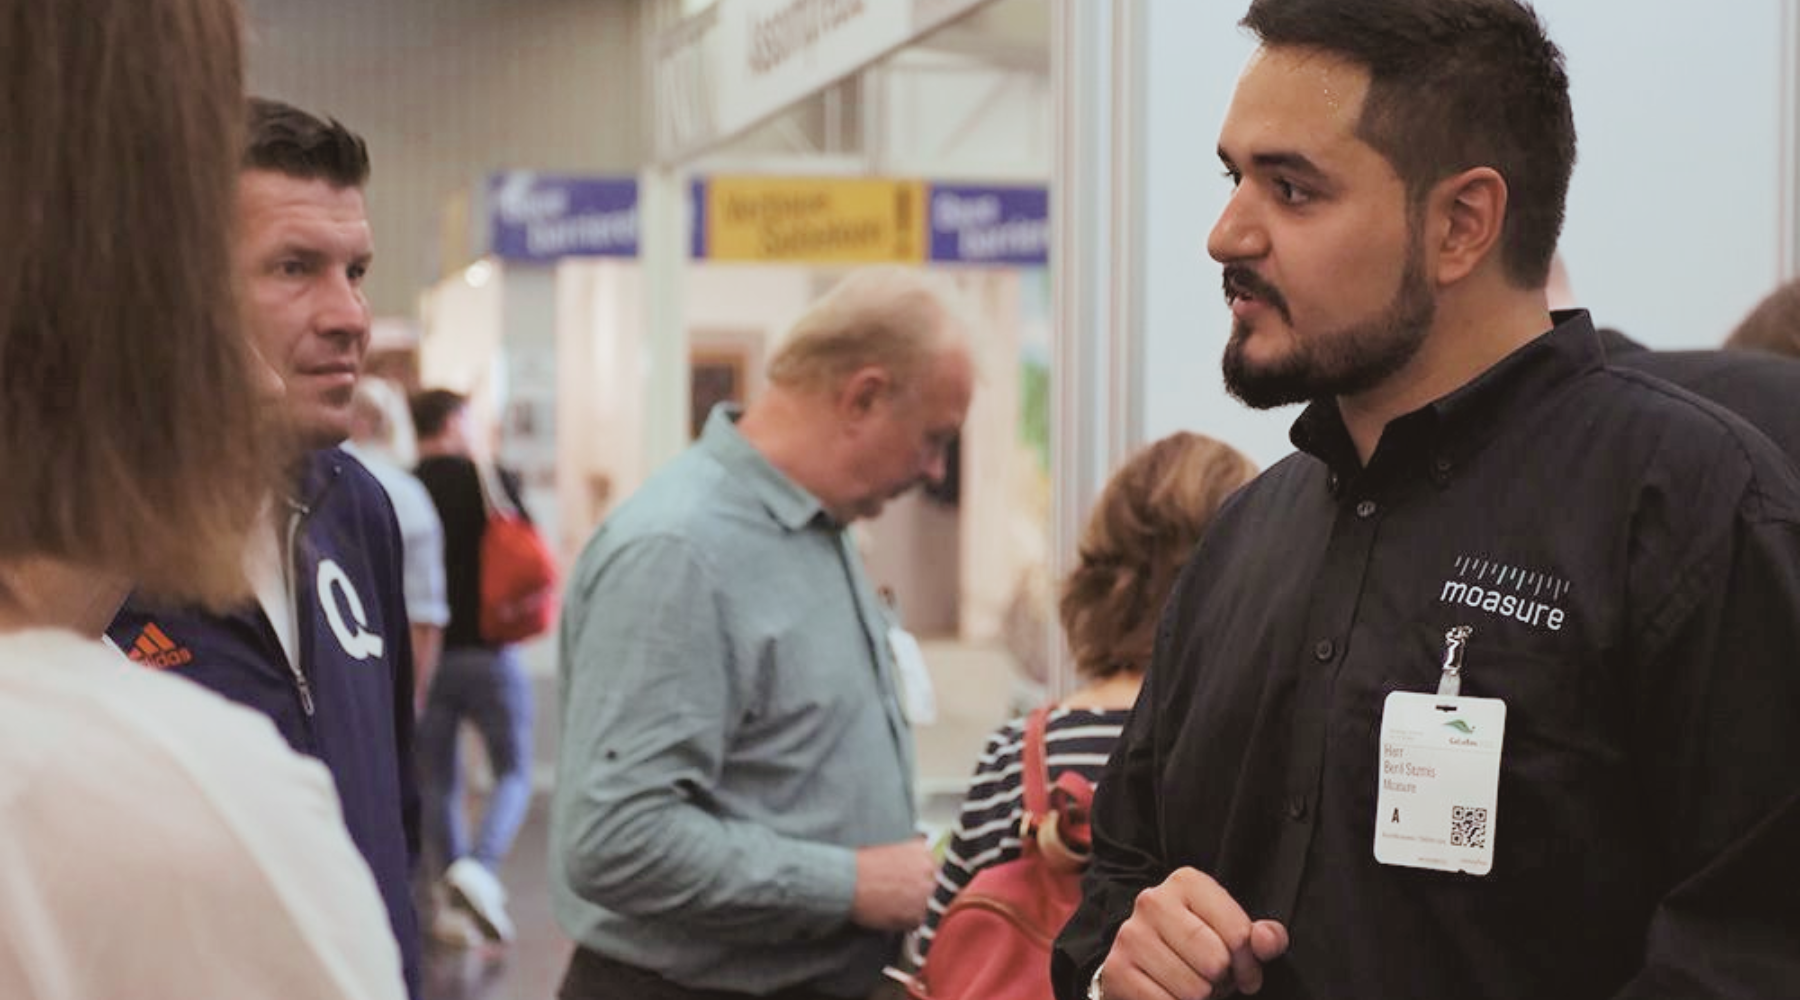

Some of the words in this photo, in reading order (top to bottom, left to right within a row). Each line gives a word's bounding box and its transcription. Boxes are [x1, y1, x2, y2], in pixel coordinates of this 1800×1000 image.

[317, 558, 384, 660] Q
[1440, 580, 1565, 631] moasure
[1390, 807, 1400, 824] A
